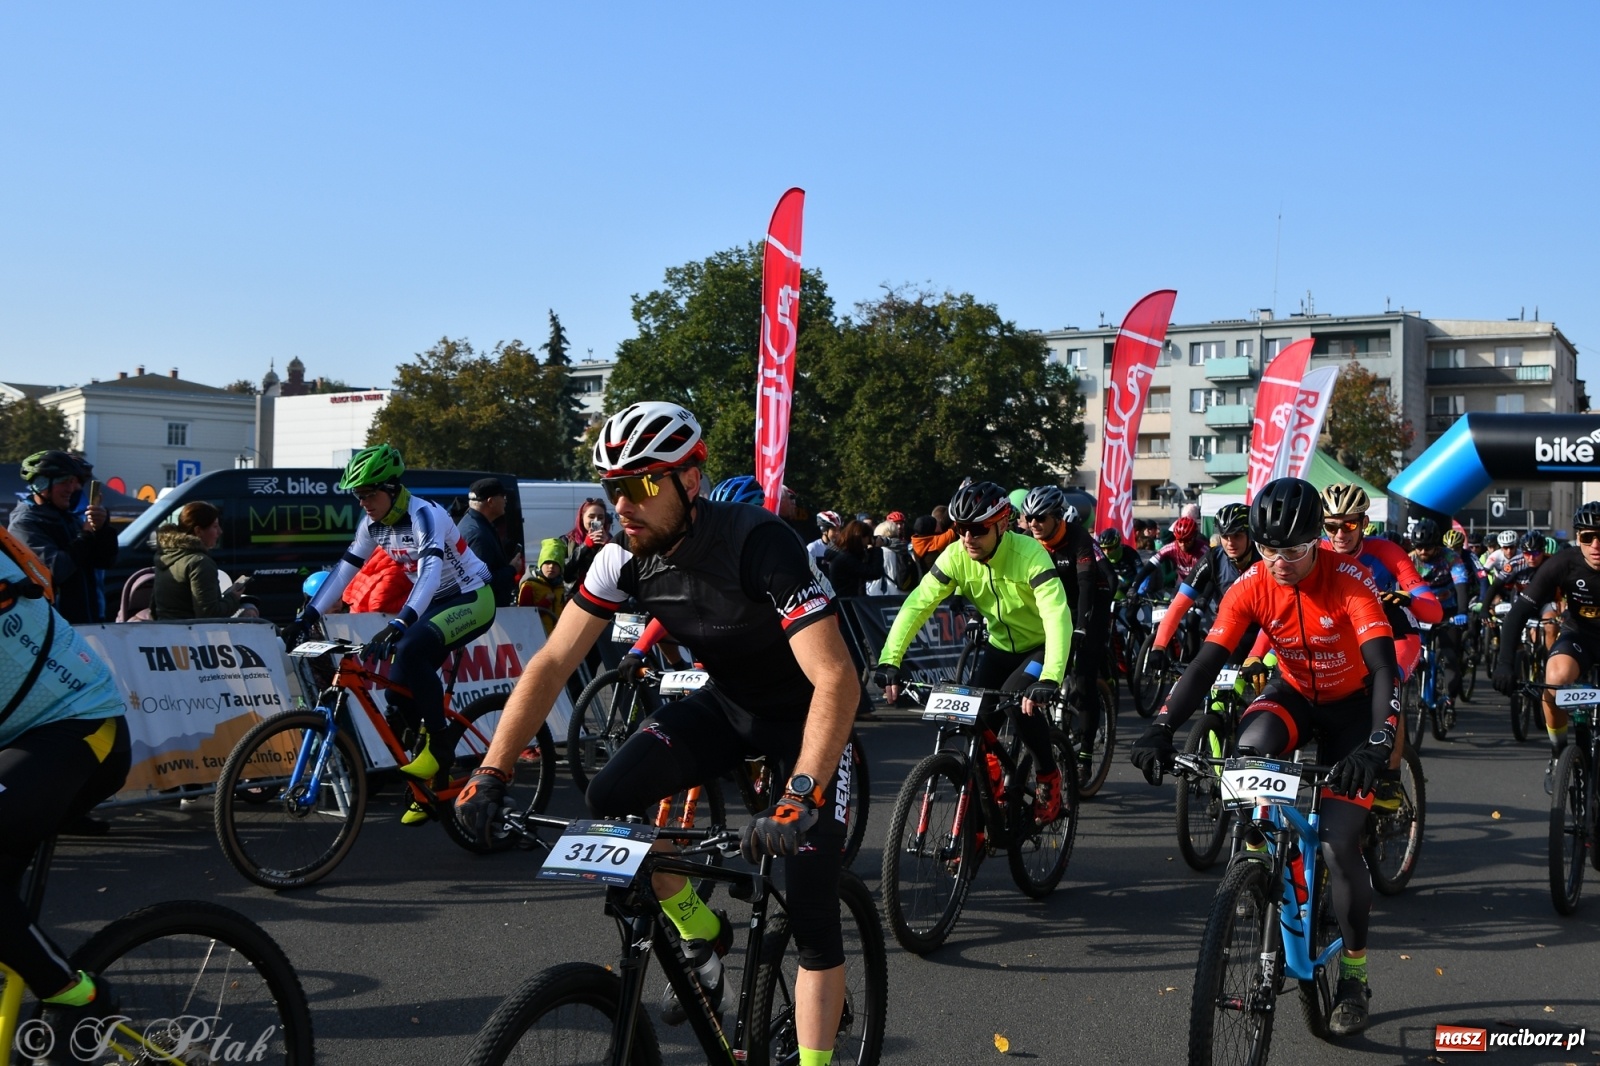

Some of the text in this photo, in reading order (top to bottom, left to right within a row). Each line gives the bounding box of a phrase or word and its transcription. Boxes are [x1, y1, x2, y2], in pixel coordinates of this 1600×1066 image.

[1535, 436, 1594, 463] bike
[287, 477, 327, 495] bike
[248, 504, 356, 531] MTBM
[1336, 562, 1363, 581] JURA
[139, 645, 237, 671] TAURUS
[671, 673, 703, 685] 1165
[934, 698, 970, 713] 2288
[1563, 692, 1597, 702] 2029
[1235, 775, 1287, 792] 1240
[564, 842, 630, 866] 3170
